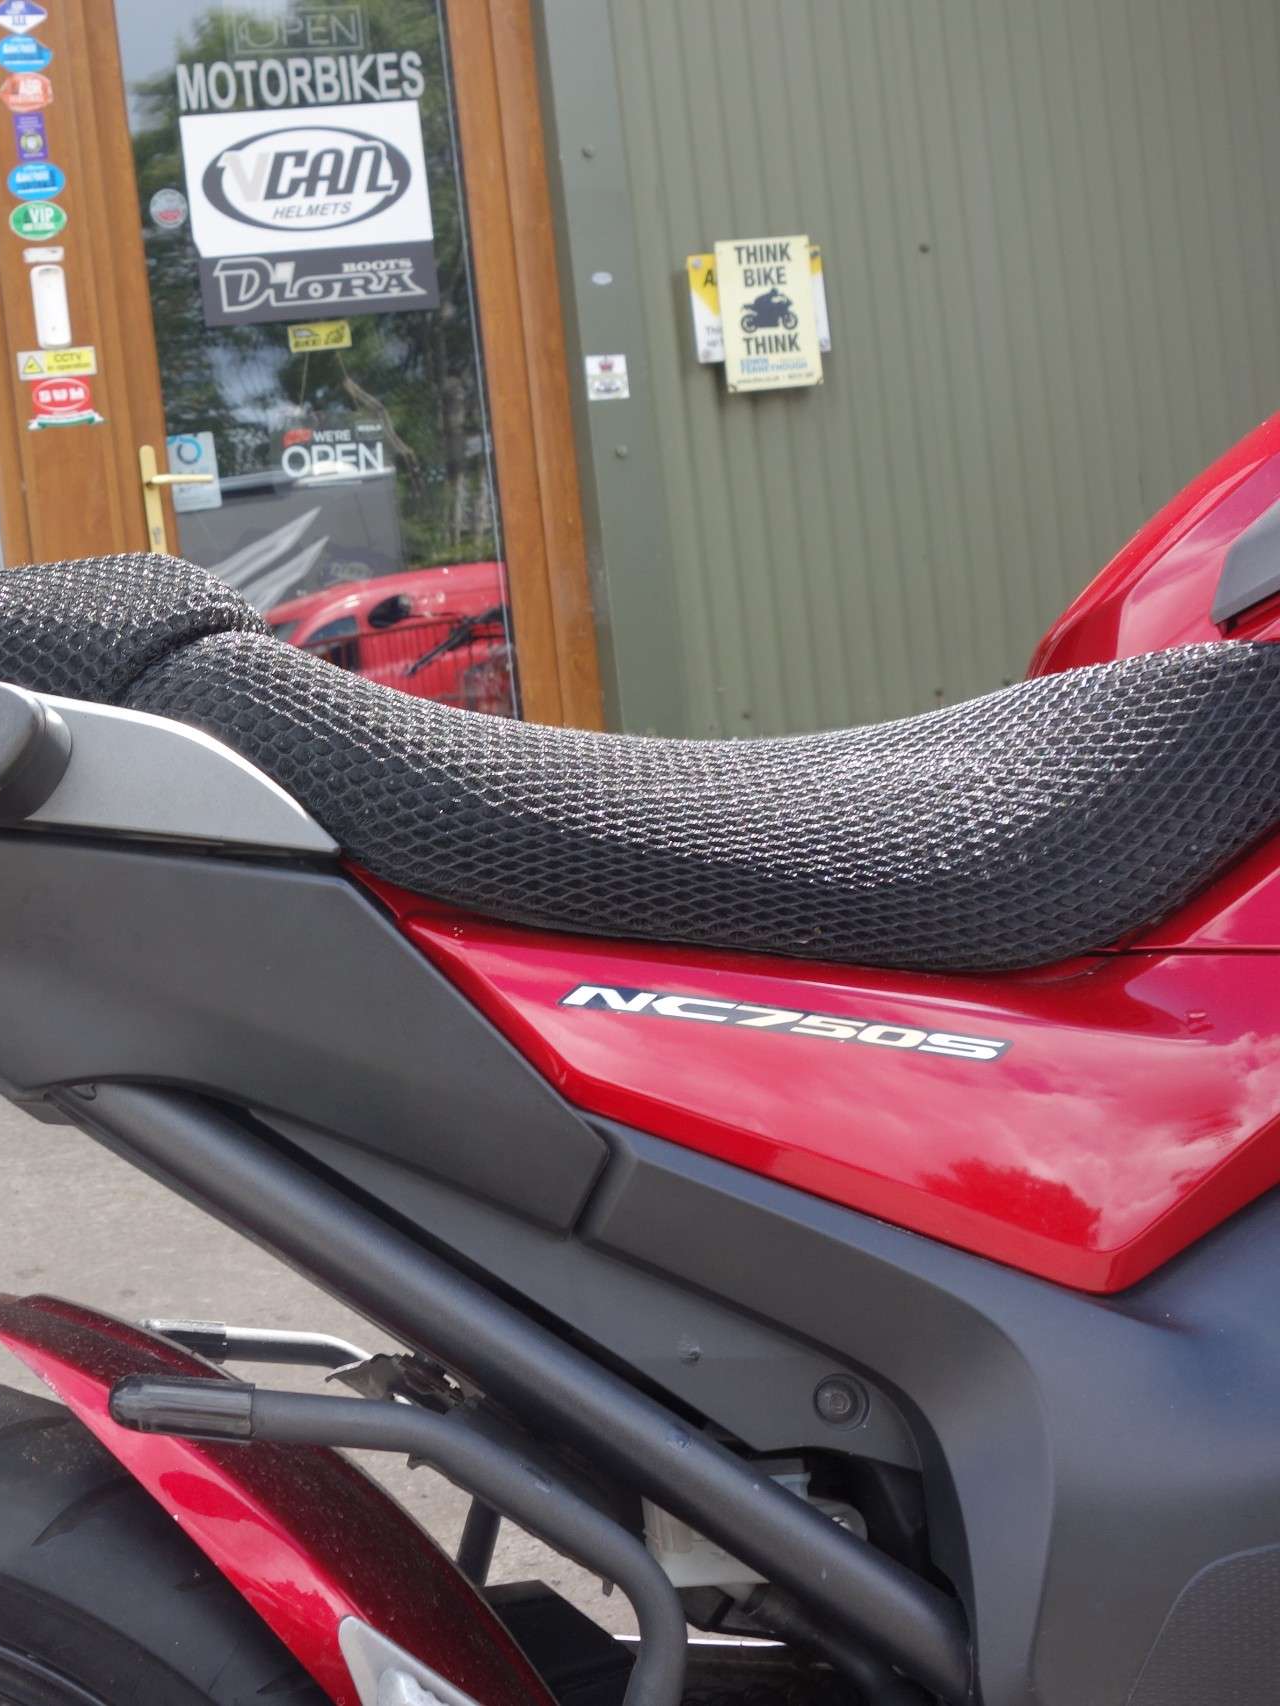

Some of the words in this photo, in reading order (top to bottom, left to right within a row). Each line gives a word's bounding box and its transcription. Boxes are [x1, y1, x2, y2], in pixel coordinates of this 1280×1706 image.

[176, 51, 425, 111] MOTORBIKES
[217, 143, 398, 203] VCAN
[28, 206, 55, 224] VIP
[273, 201, 352, 220] HELMETS
[734, 243, 792, 265] THINK
[342, 258, 413, 273] BOOTS
[743, 266, 787, 288] BIKE
[742, 333, 801, 356] THINK
[54, 352, 82, 363] CCTV
[313, 429, 351, 443] WE'RE
[281, 441, 384, 478] OPEN
[561, 984, 1006, 1061] NC750S
